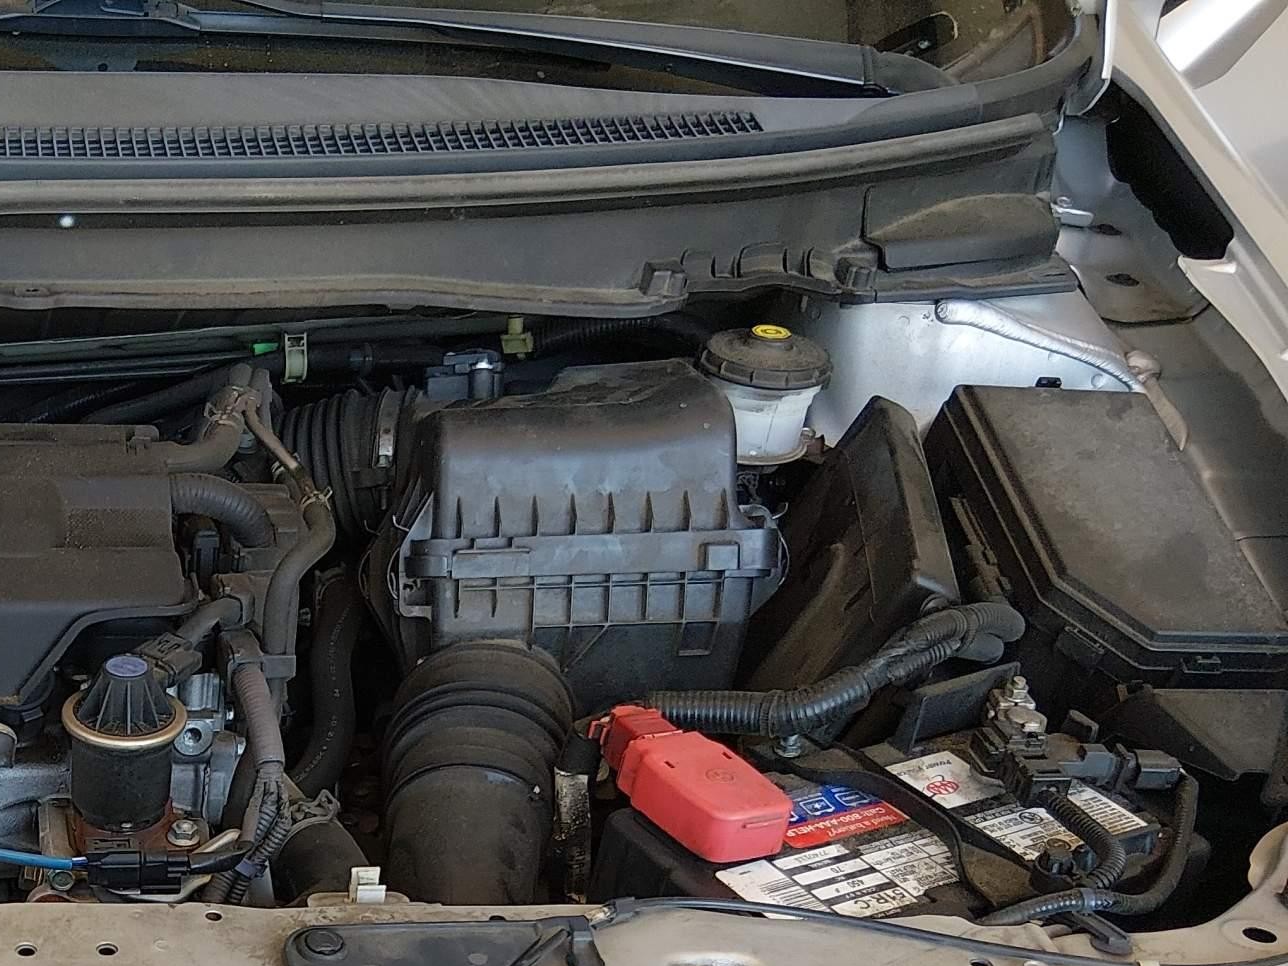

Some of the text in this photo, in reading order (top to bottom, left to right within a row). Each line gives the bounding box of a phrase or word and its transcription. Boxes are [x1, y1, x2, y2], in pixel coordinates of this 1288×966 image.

[927, 781, 958, 795] AAA
[785, 806, 887, 838] Call: 800-AAA-HELP
[848, 879, 865, 889] 450
[853, 888, 906, 910] 51R-C
